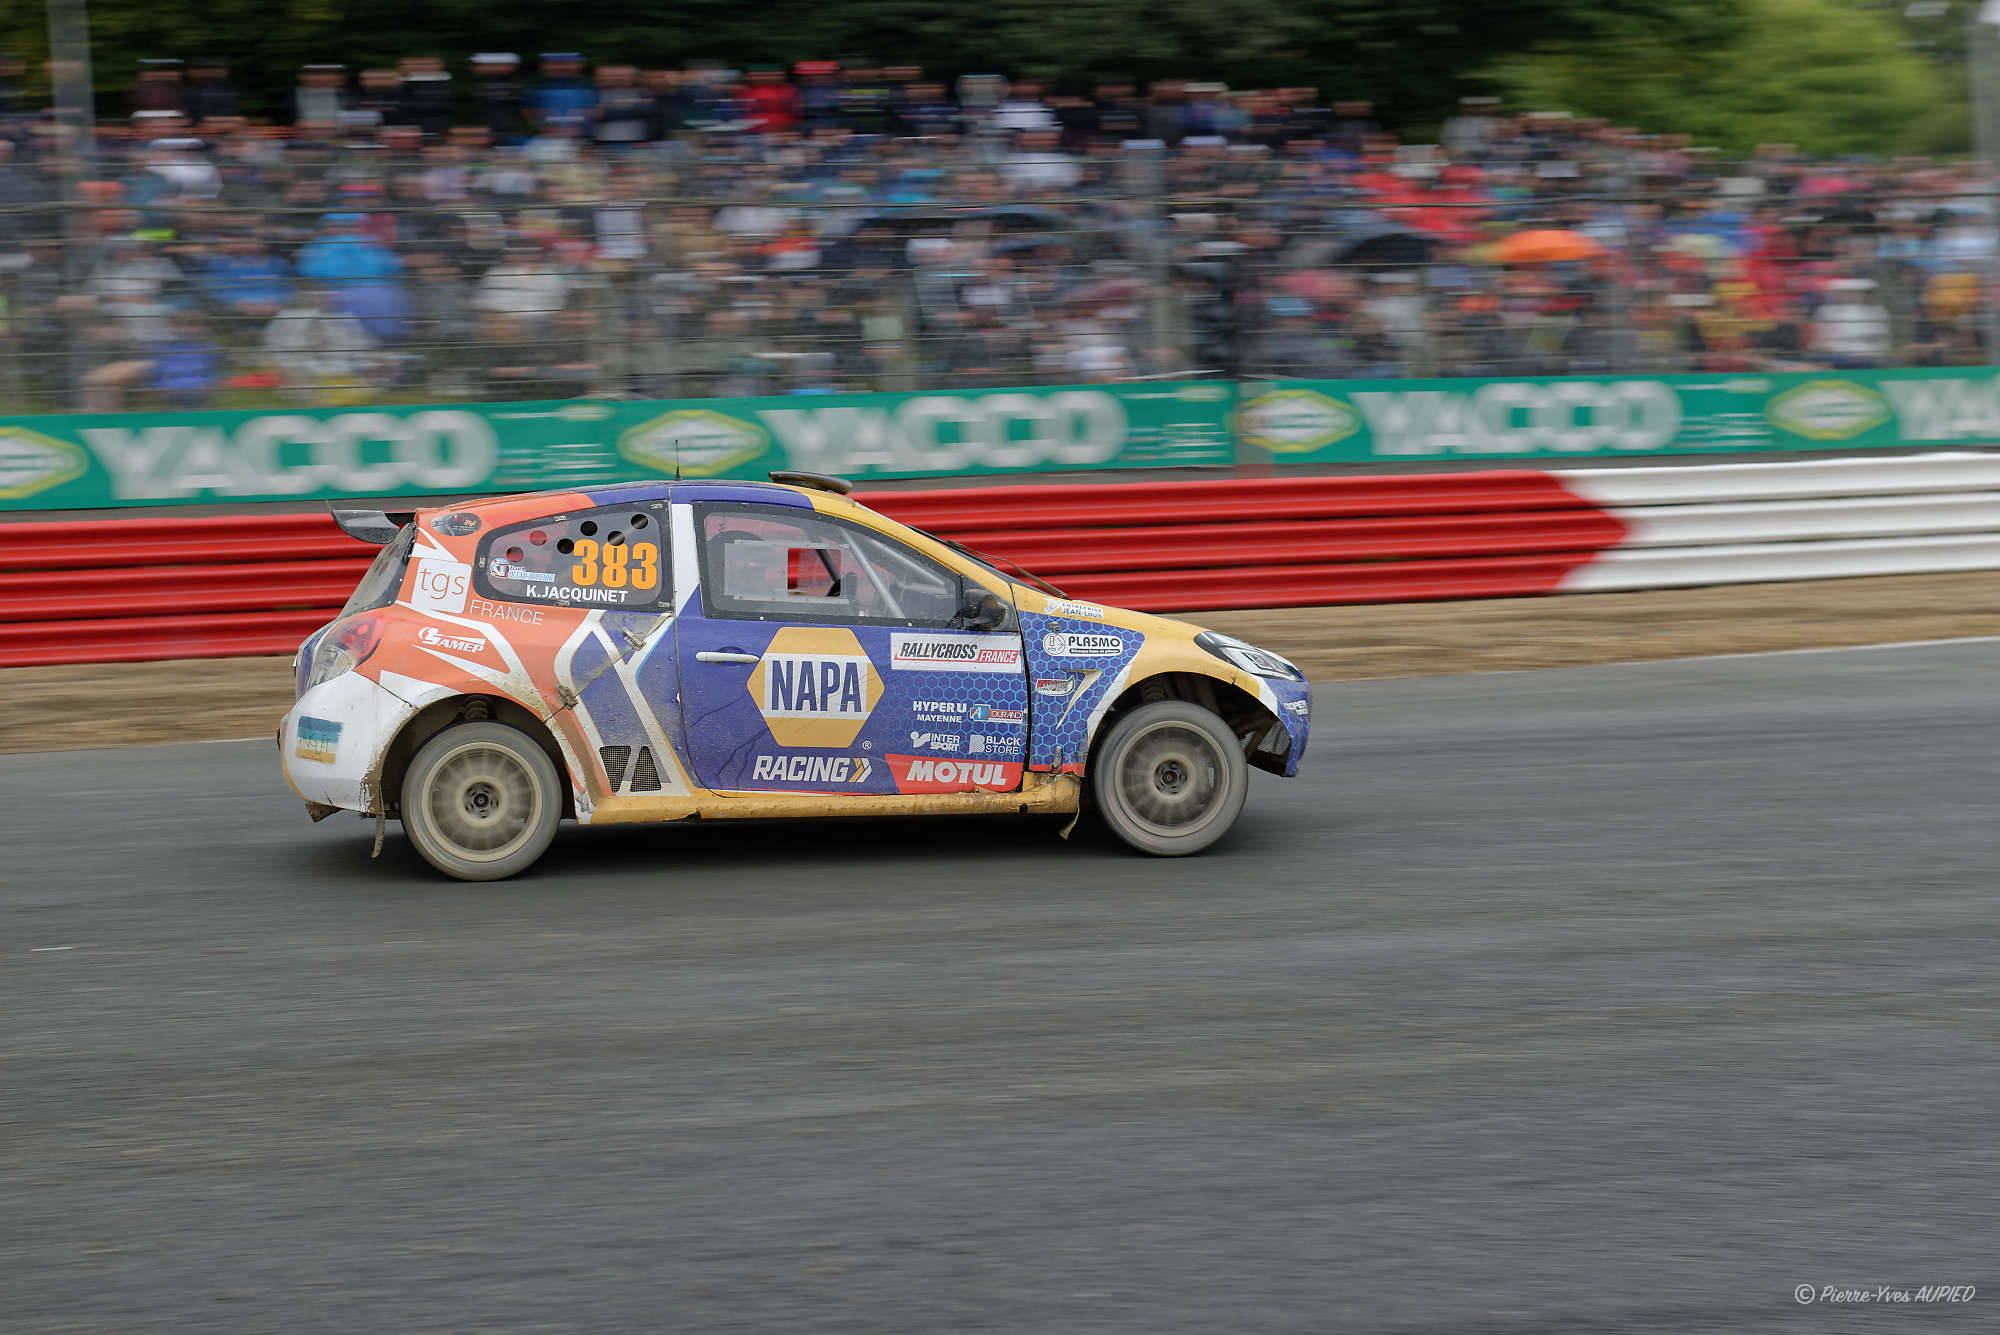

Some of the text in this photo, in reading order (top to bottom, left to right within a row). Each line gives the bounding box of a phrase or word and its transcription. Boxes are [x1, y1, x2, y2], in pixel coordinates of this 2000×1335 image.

[1350, 381, 1681, 455] YACCO
[758, 391, 1128, 473] YACCO
[78, 410, 498, 499] YACCO
[572, 539, 657, 590] 383
[420, 567, 466, 600] tgs
[526, 584, 628, 603] K.JACQUINET
[469, 599, 545, 626] FRANCE
[900, 642, 1017, 664] RALLYCROSS FRANCE
[1068, 636, 1121, 648] PLASMO
[772, 660, 862, 712] NAPA
[913, 700, 967, 713] HYPER U
[917, 714, 962, 723] MAYENNE
[930, 742, 960, 752] SPORT
[931, 733, 960, 744] INTER
[985, 745, 1020, 755] STORE
[986, 735, 1021, 746] BLACK
[752, 755, 850, 783] RACING
[906, 760, 1007, 785] MOTUL
